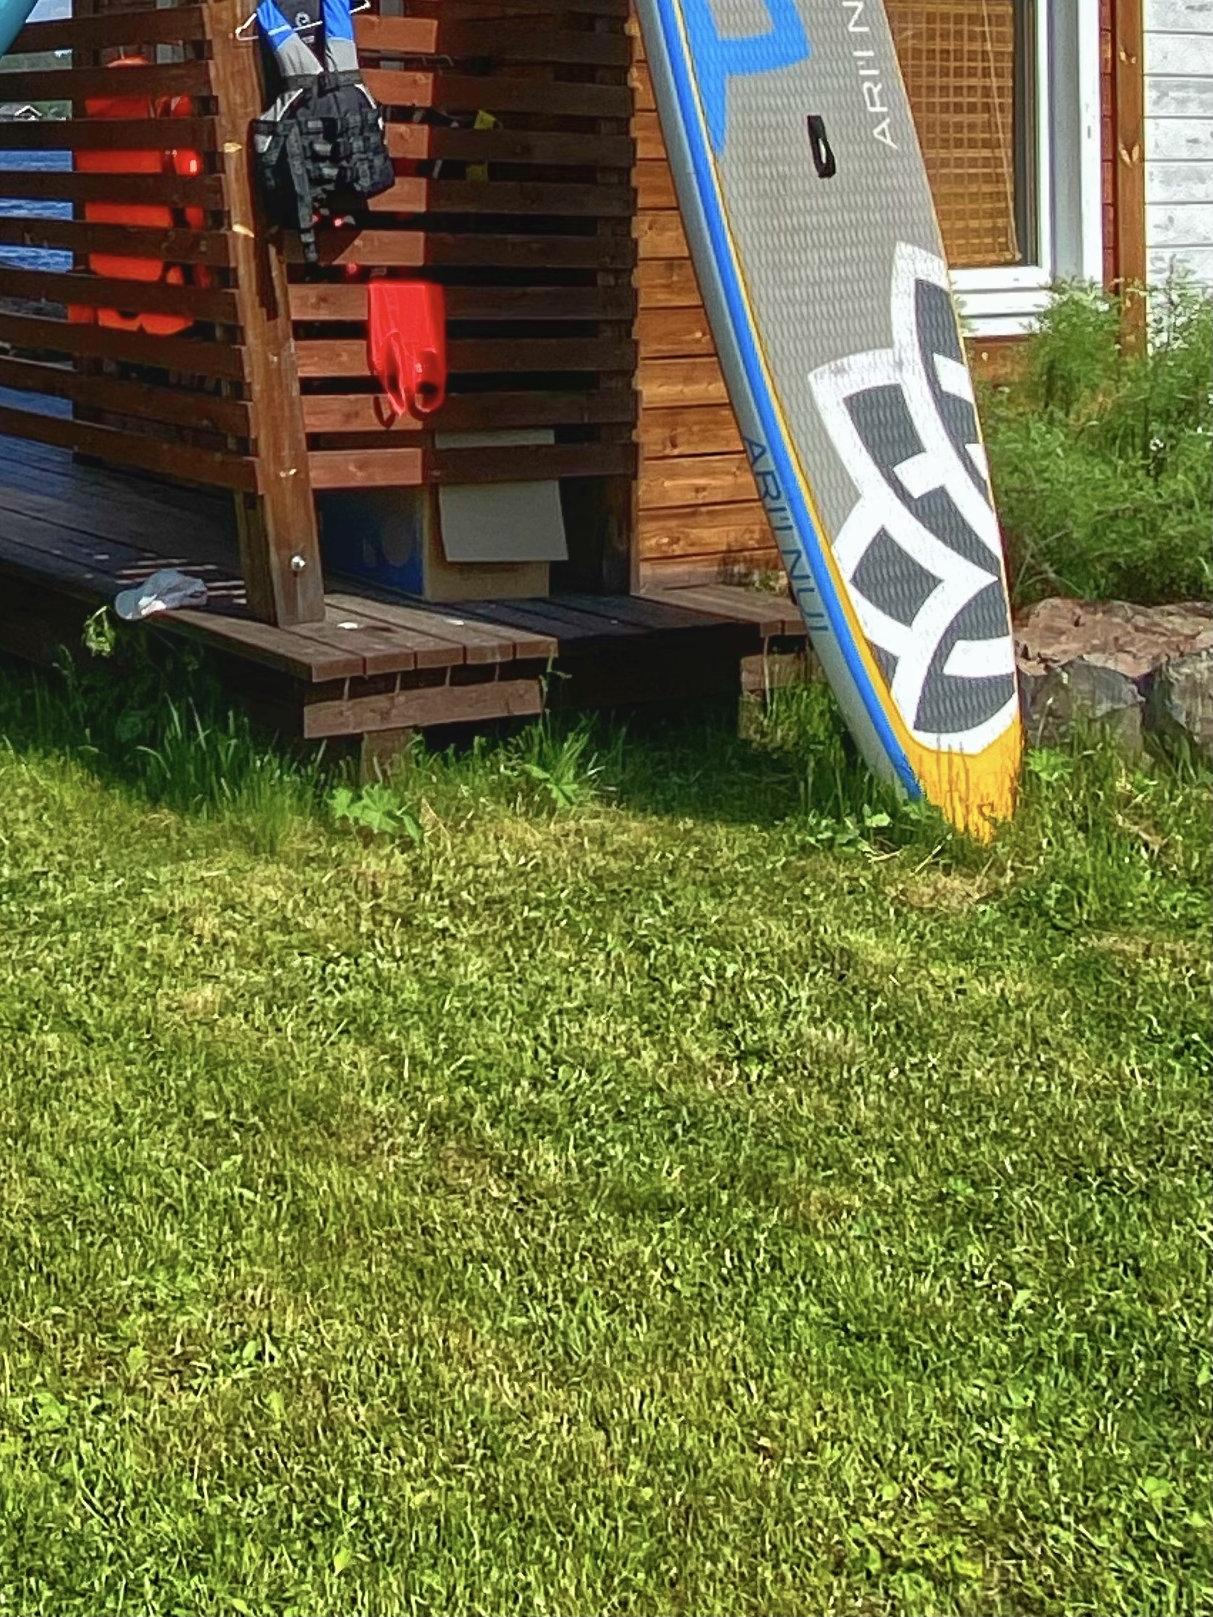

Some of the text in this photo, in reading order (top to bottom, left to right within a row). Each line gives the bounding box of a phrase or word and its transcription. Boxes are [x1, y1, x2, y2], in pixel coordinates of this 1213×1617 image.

[852, 49, 899, 151] ARI'I
[743, 437, 829, 631] ARI'I NUI
